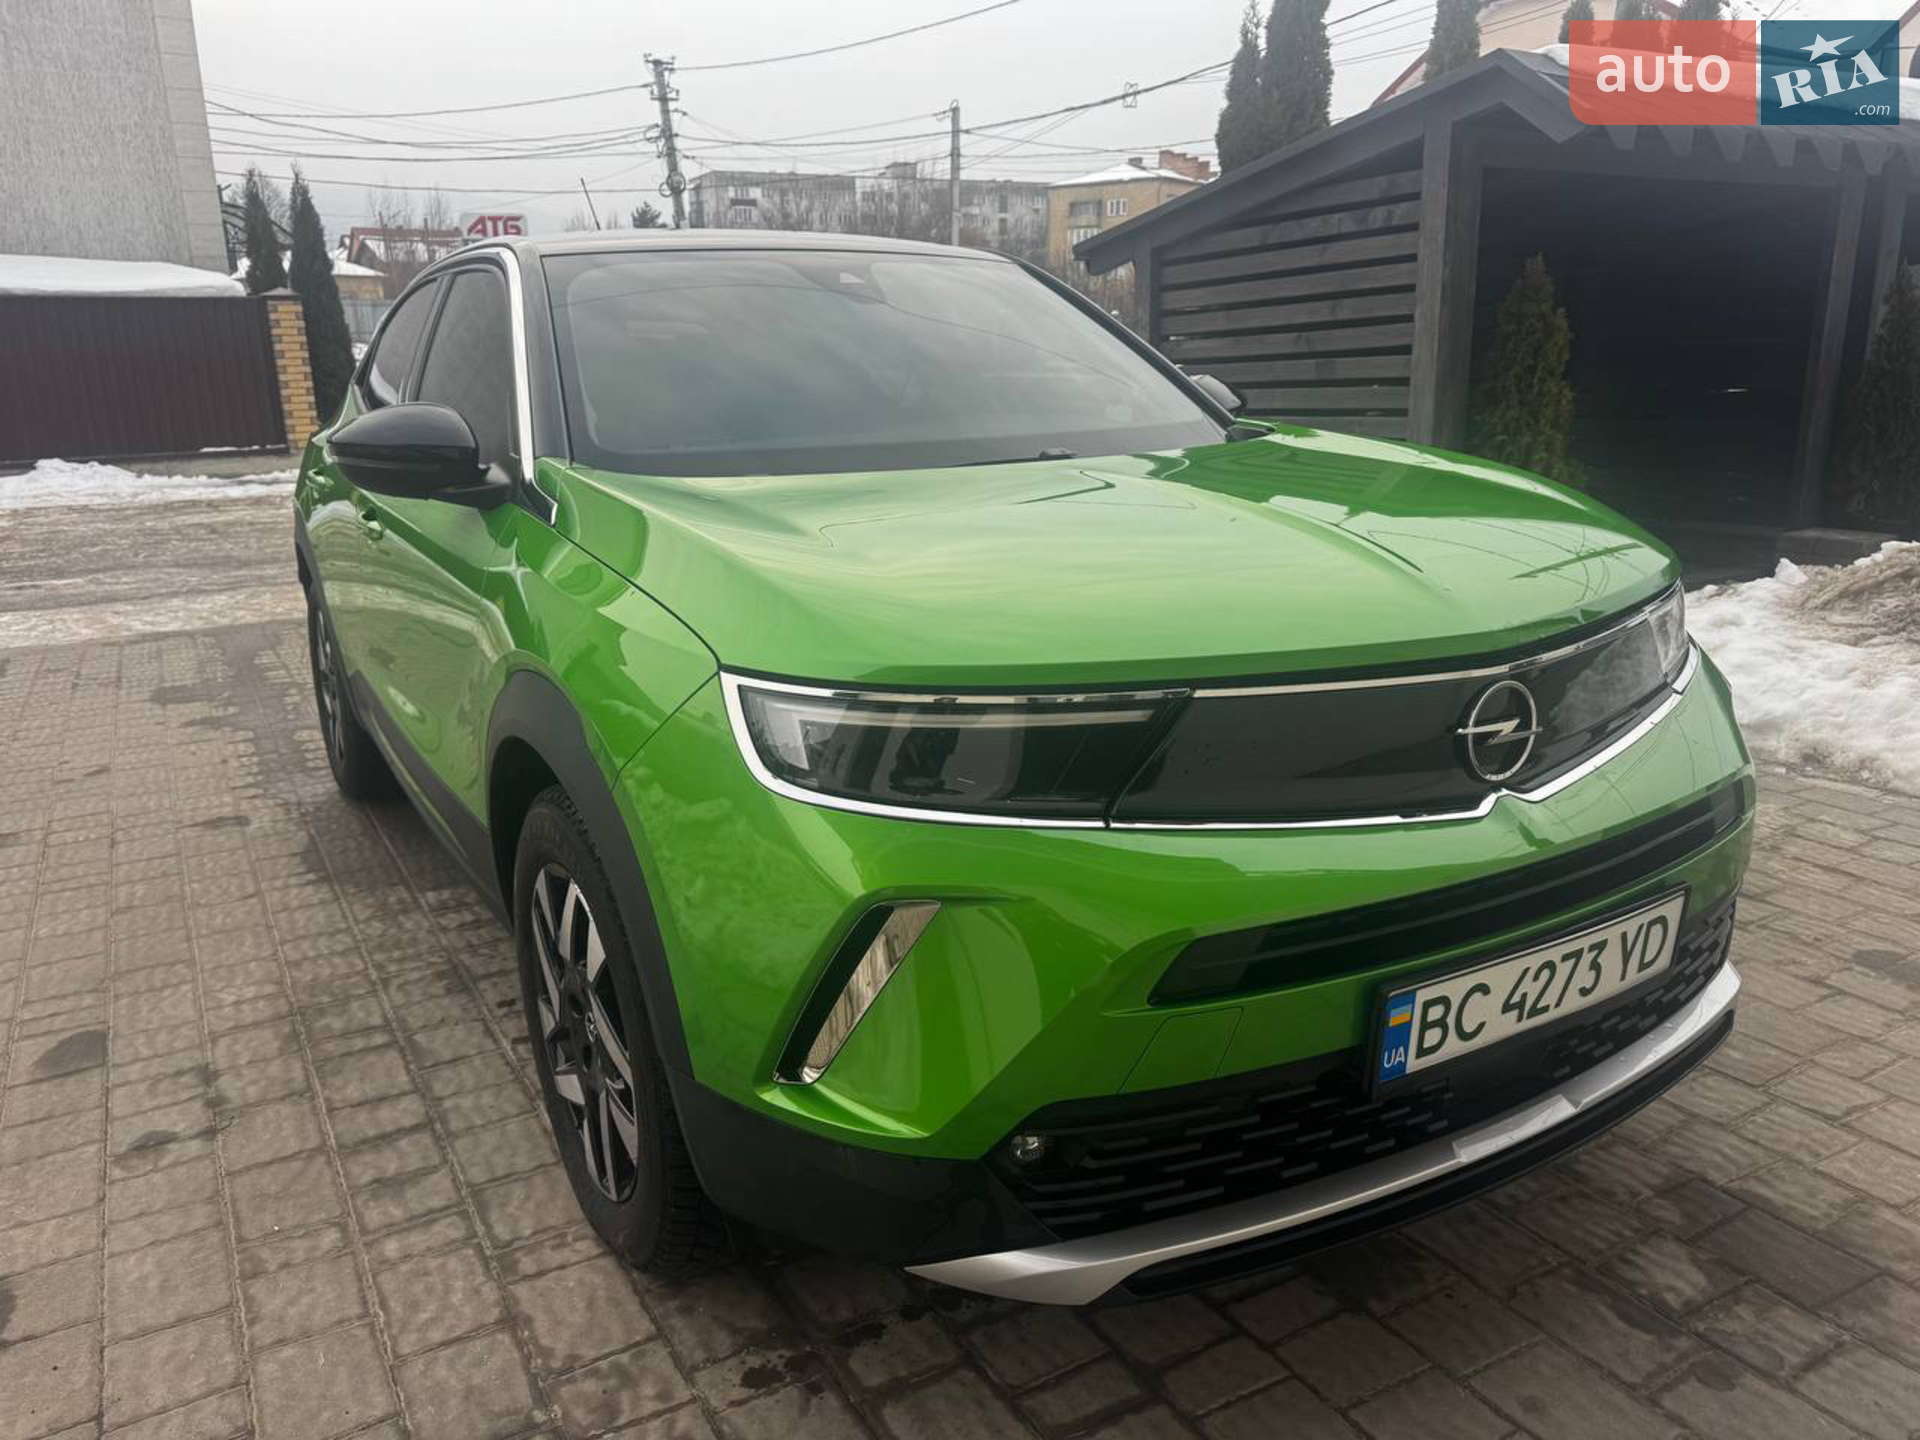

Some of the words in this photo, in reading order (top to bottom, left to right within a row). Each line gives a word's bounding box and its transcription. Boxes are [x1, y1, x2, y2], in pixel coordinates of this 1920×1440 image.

[467, 215, 524, 238] АТБ
[1415, 982, 1491, 1060] BC
[1501, 938, 1608, 1024] 4273
[1620, 914, 1669, 982] YD
[1383, 1046, 1406, 1068] UA
